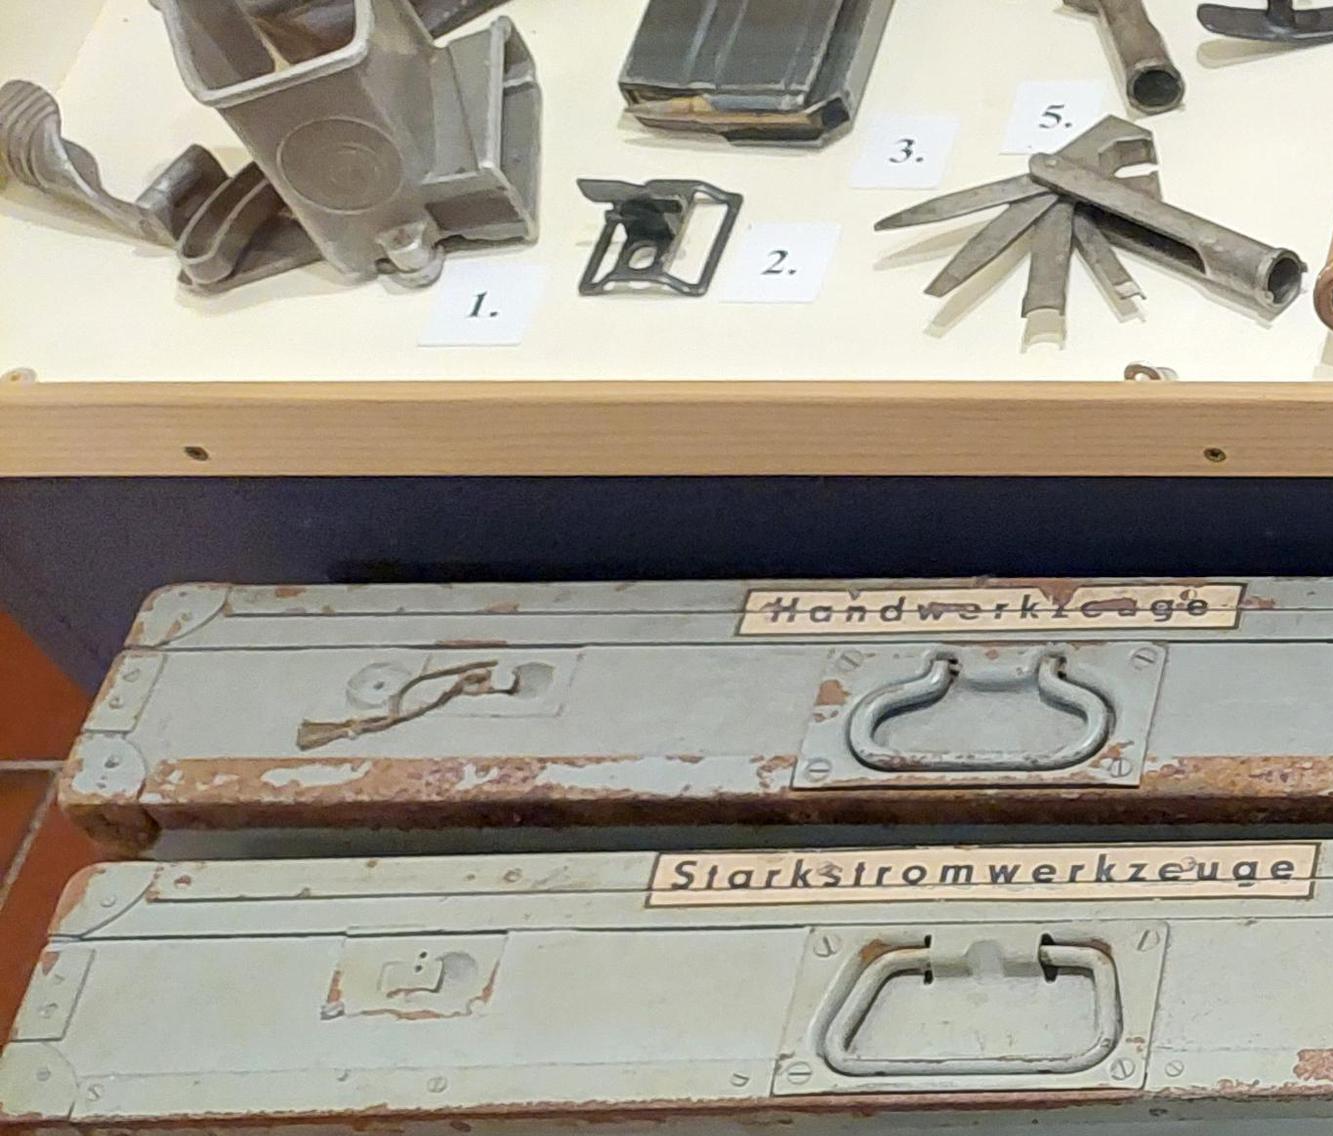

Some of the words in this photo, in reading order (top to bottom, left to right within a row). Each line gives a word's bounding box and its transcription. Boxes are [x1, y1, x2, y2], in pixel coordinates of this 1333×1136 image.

[1039, 104, 1073, 129] 5.
[888, 138, 924, 164] 3.
[763, 249, 798, 275] 2.
[466, 292, 499, 318] 1.
[768, 593, 1210, 624] Handwerkzeuge
[670, 853, 1296, 890] Starkstromwerkzeuge
